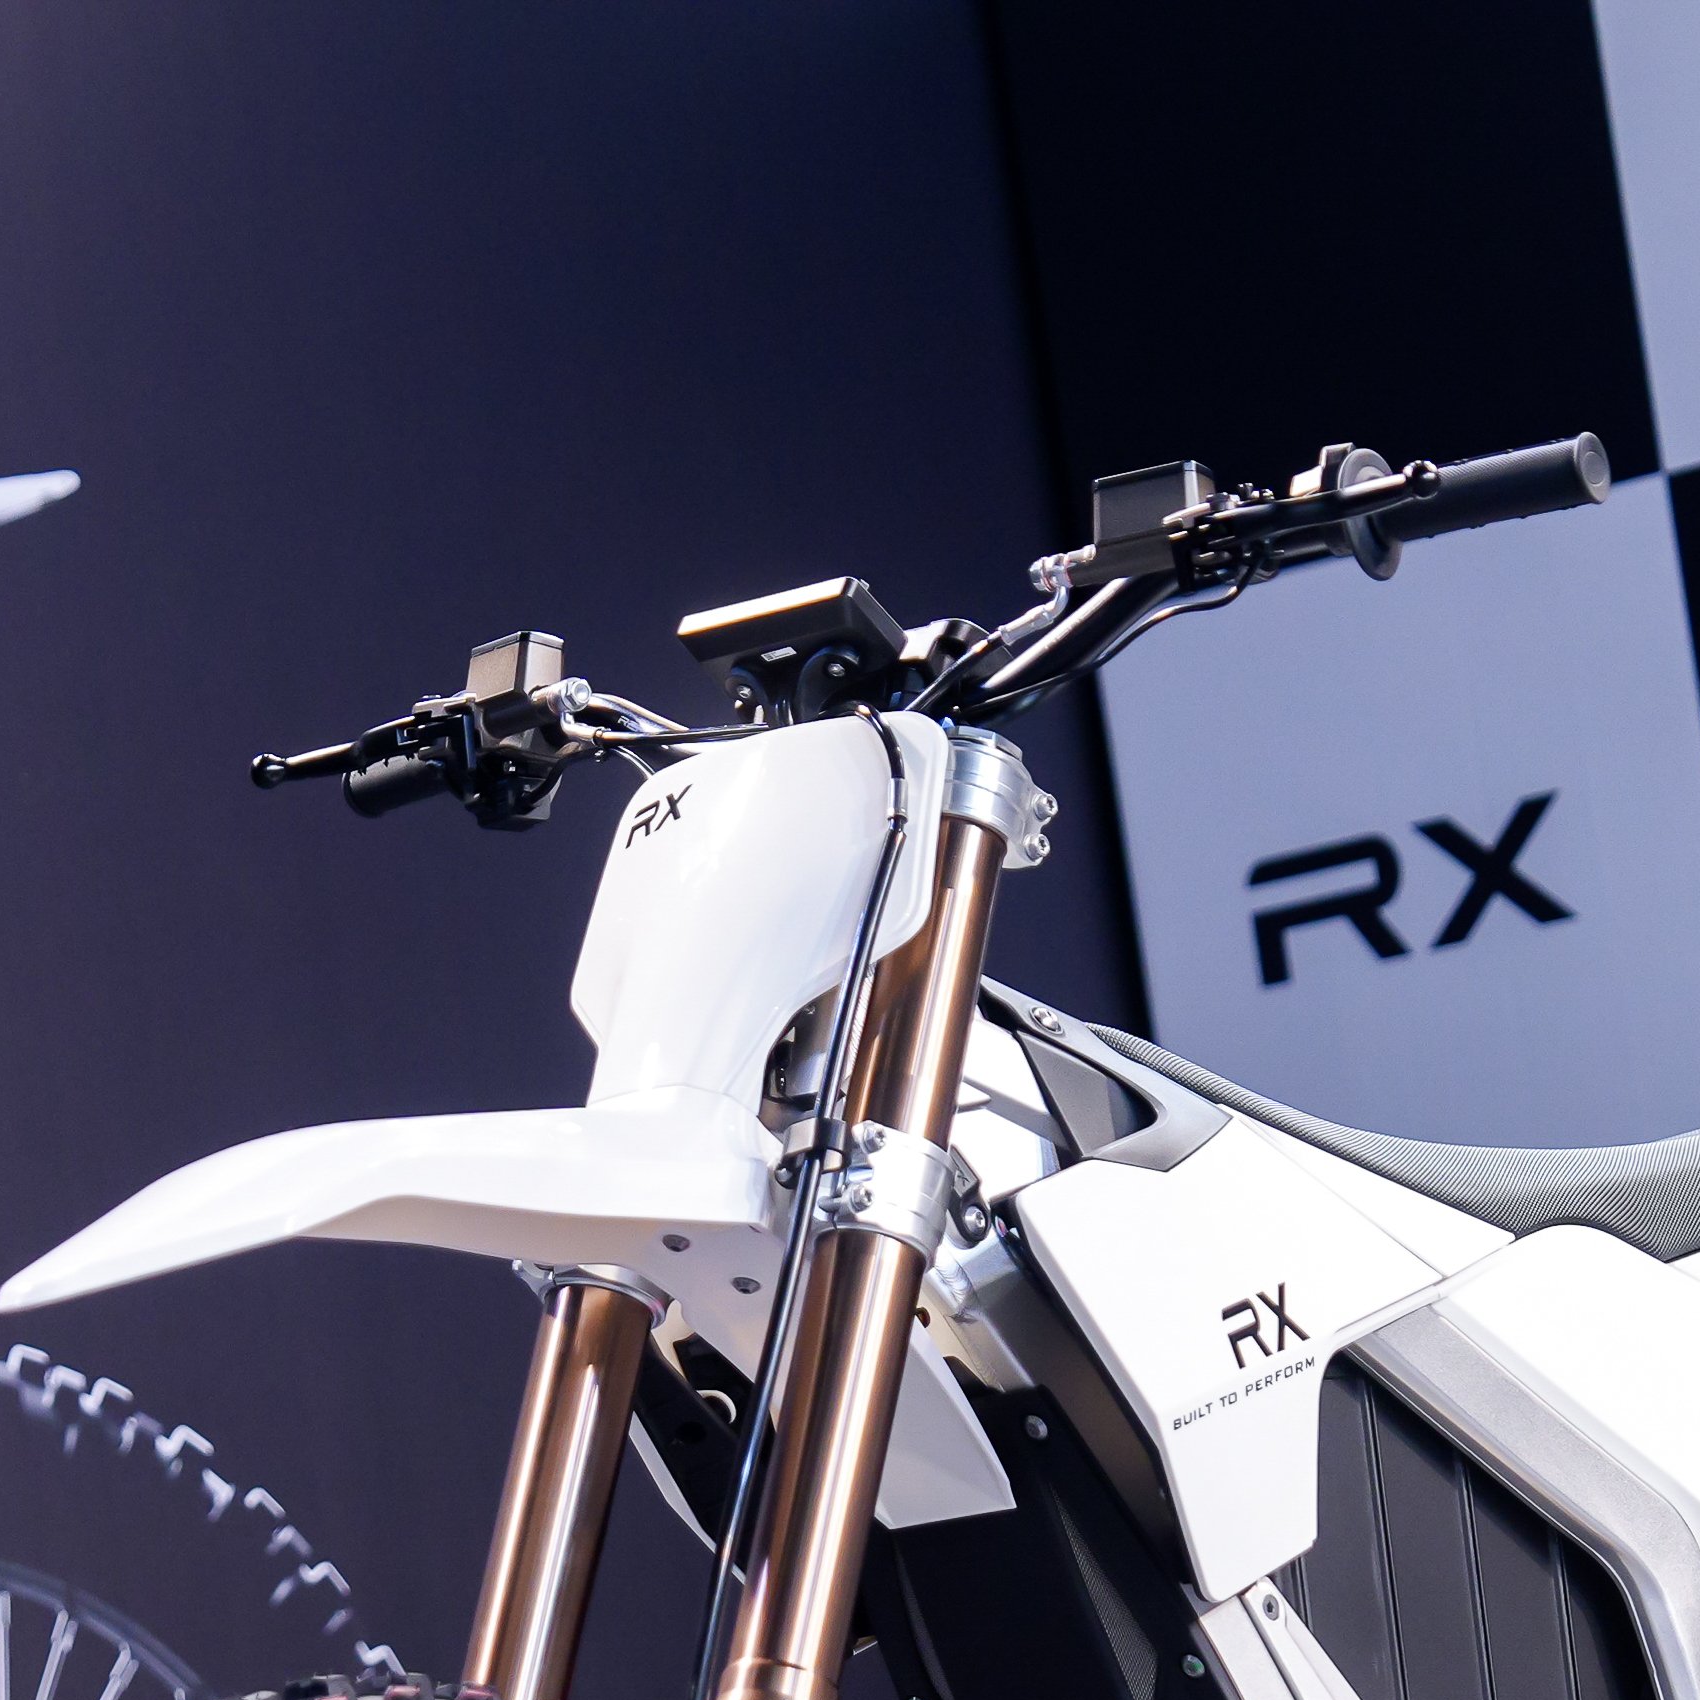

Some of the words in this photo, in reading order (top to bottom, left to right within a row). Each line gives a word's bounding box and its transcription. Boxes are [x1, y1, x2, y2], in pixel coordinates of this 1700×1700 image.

[625, 784, 692, 849] RX
[1247, 792, 1574, 987] RX
[1221, 1281, 1311, 1370] RX
[1173, 1402, 1214, 1431] BUILT
[1219, 1392, 1238, 1408] TO
[1245, 1356, 1315, 1397] PERFORM
